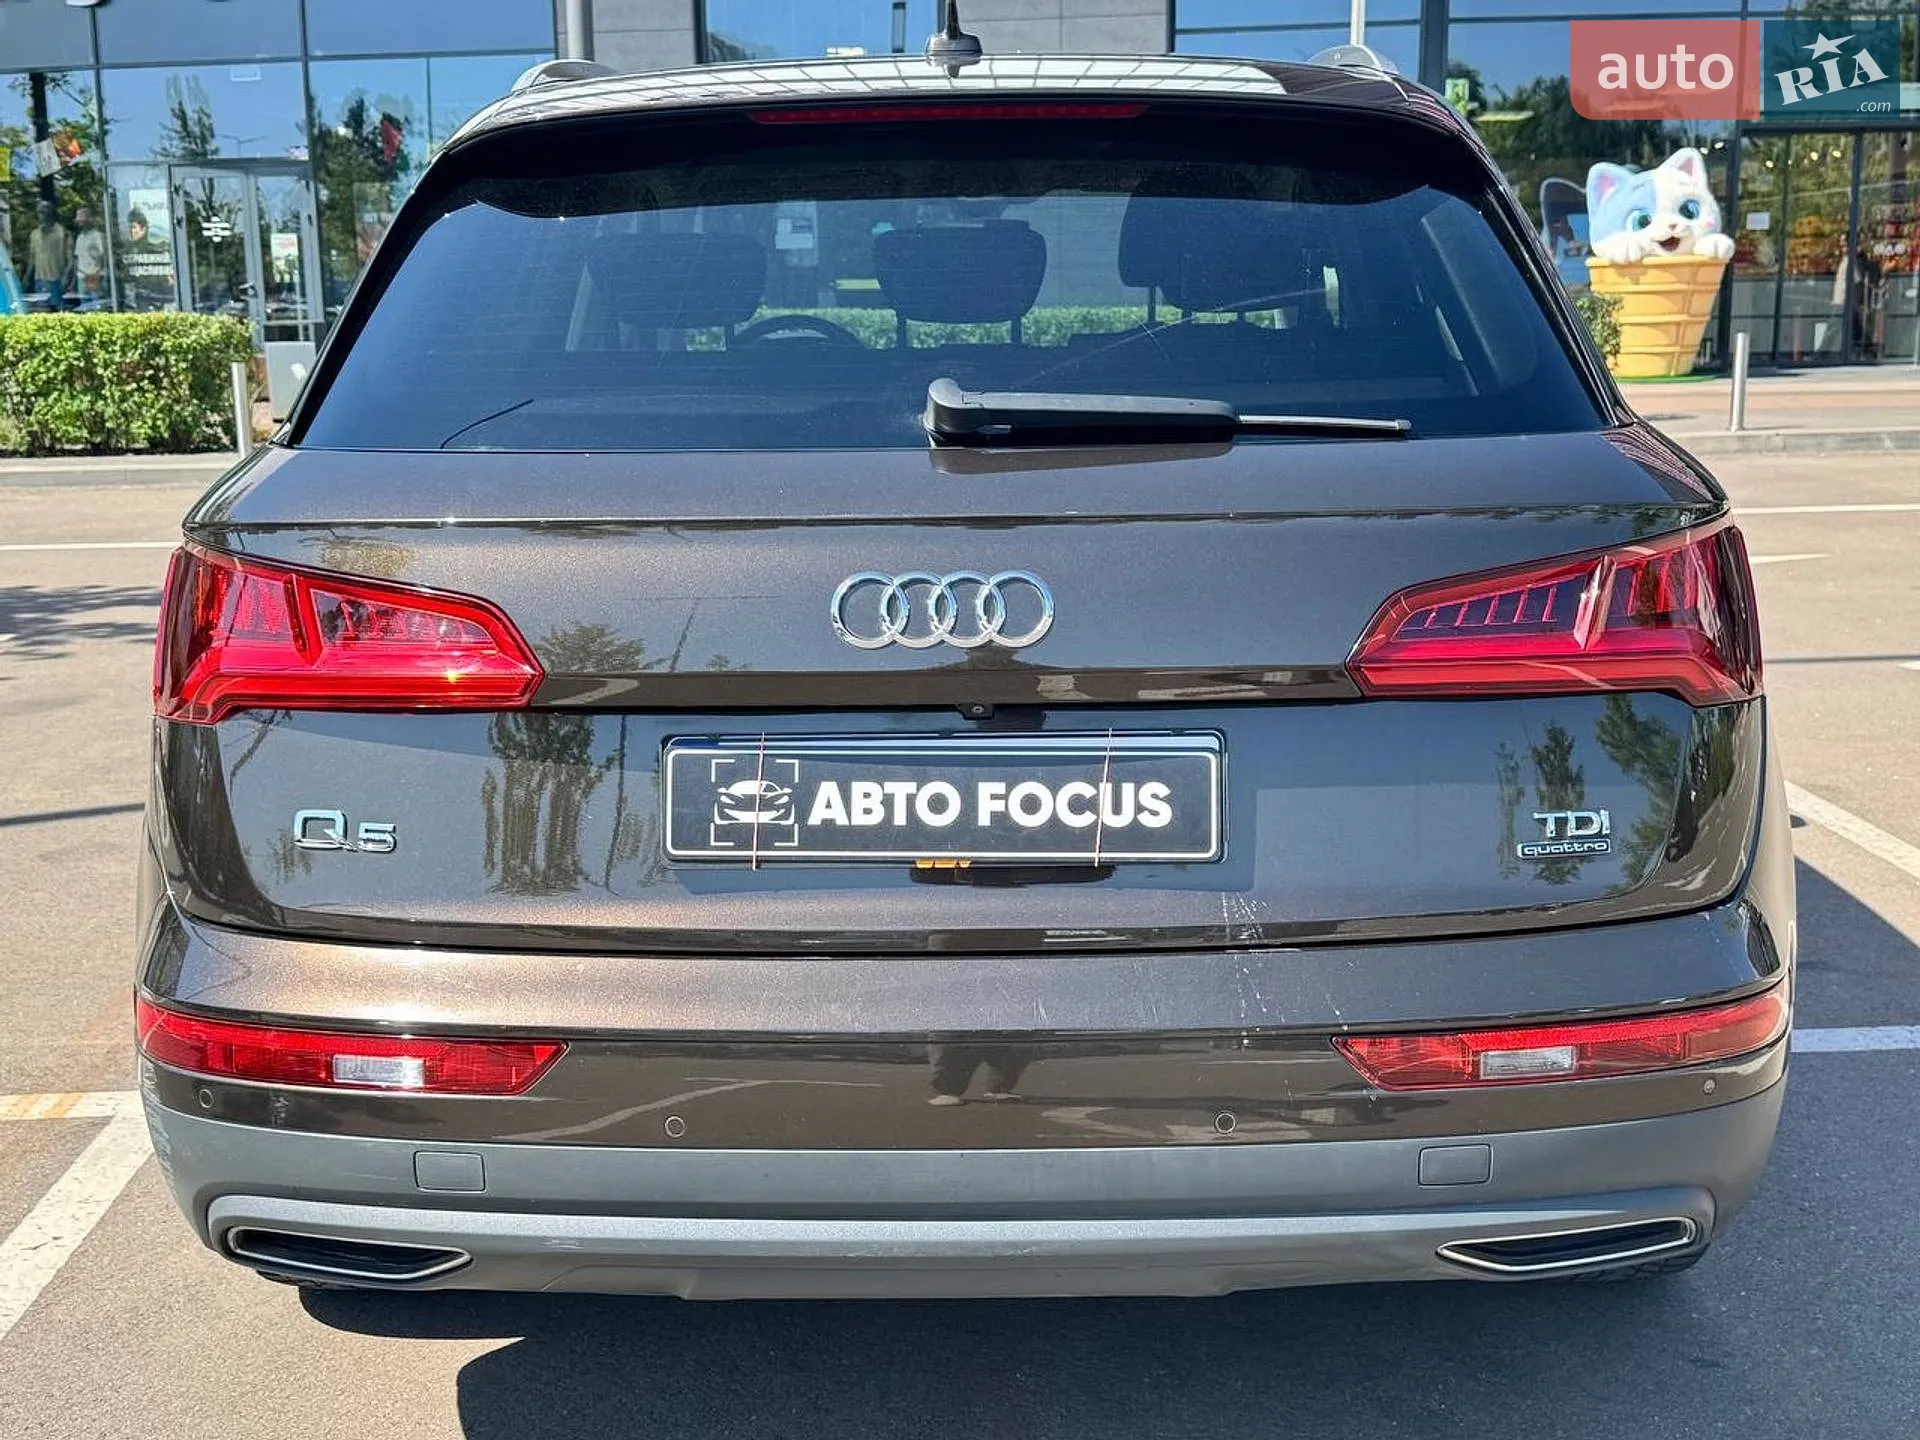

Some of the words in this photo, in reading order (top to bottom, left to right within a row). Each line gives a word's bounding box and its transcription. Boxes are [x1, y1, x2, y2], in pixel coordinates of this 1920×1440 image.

[978, 780, 1173, 828] FOCUS
[293, 808, 398, 853] Q5
[1532, 809, 1611, 837] TDI
[1523, 842, 1608, 857] quattro
